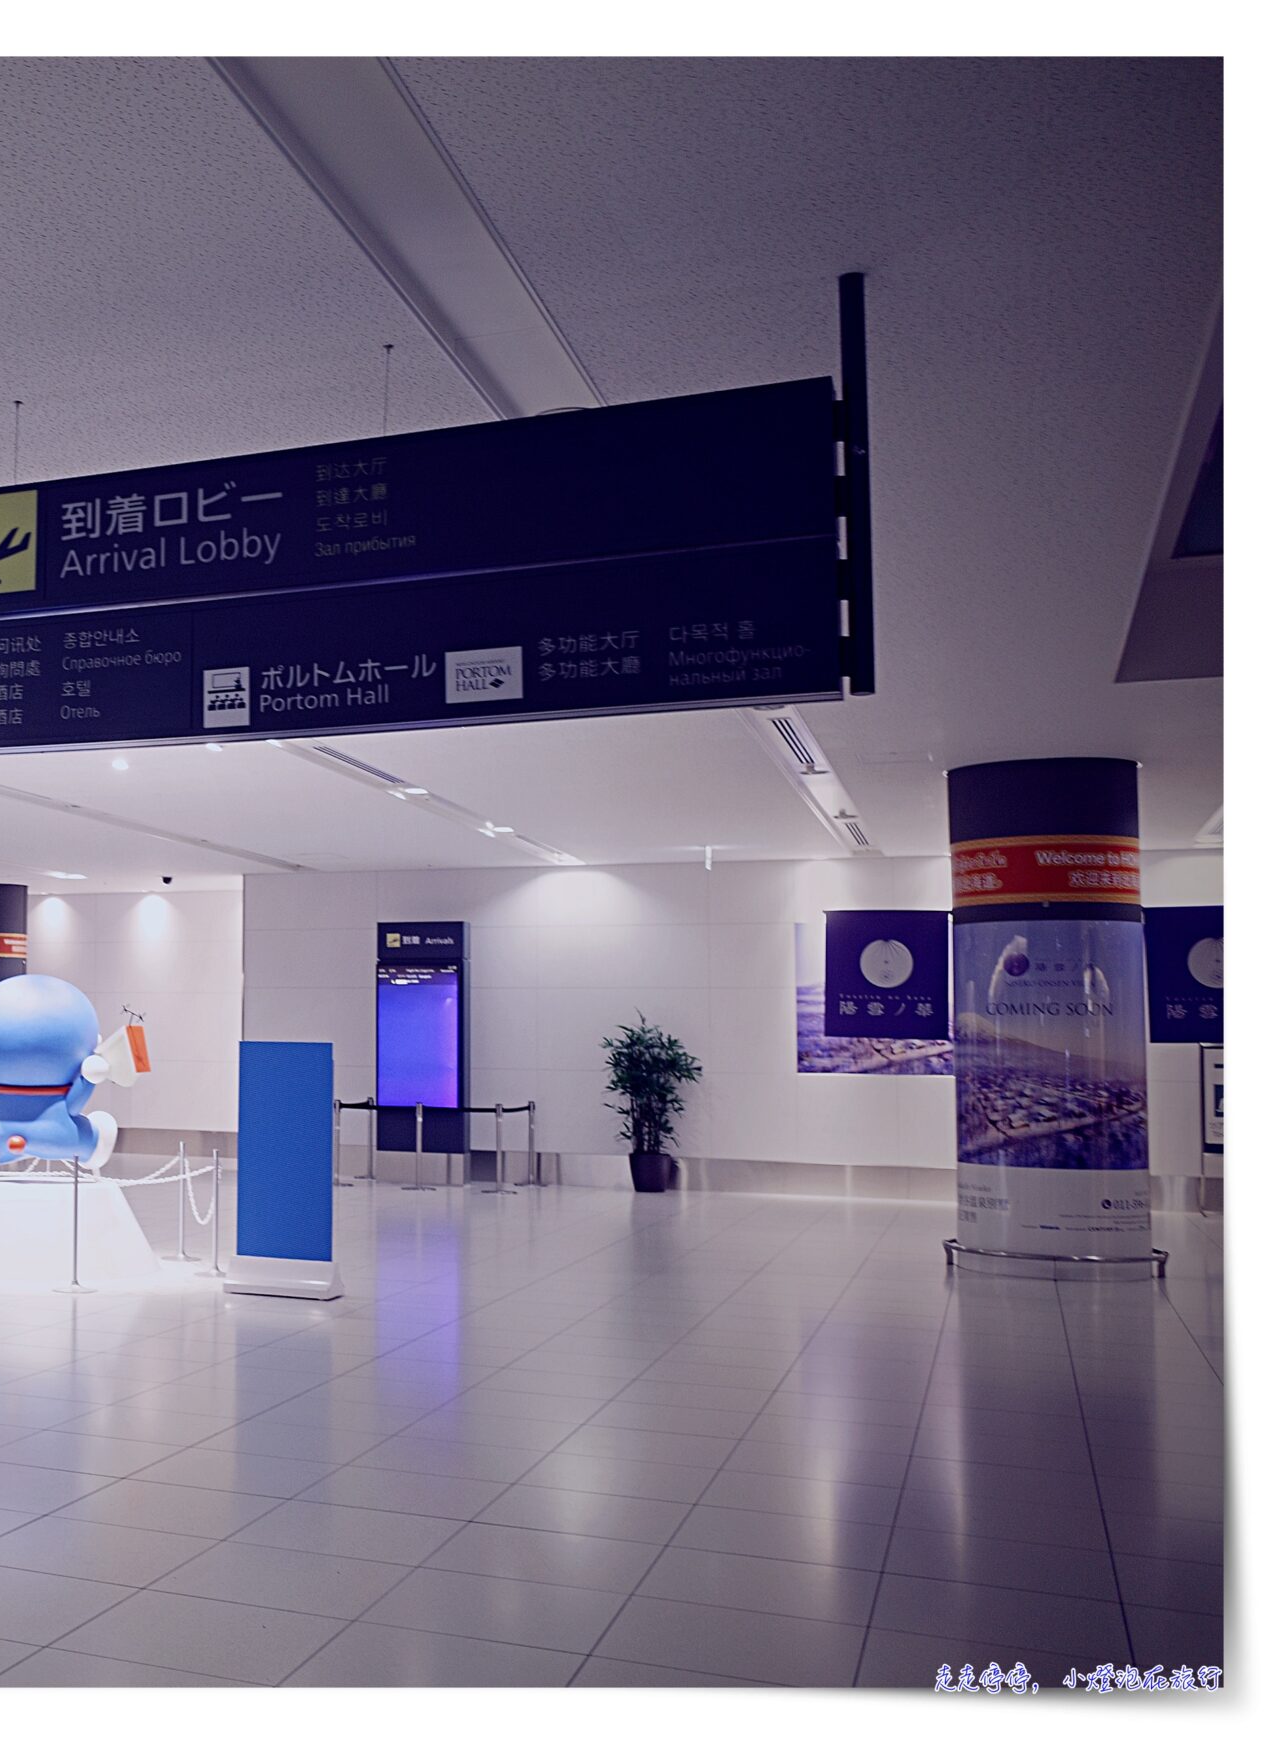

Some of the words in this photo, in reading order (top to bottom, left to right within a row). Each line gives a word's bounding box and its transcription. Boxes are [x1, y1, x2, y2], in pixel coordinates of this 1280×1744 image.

[61, 481, 283, 541] 到着ロビー
[316, 509, 387, 532] 도착로비
[60, 537, 165, 578] Arrival
[180, 527, 281, 565] Lobby
[314, 541, 341, 557] Зал
[345, 535, 416, 556] прибытия
[63, 628, 140, 649] 종합안내소
[670, 622, 729, 643] 다목적
[737, 620, 755, 640] 홀
[538, 630, 640, 656] 多功能大厅
[62, 654, 141, 673] Справочное
[144, 650, 181, 667] бюро
[261, 653, 437, 690] ポルトムホール
[456, 665, 512, 680] PORTOM
[538, 656, 641, 681] 多功能大廳
[456, 679, 489, 692] HALL
[670, 665, 746, 687] нальный
[752, 666, 783, 681] зал
[61, 680, 91, 697] 호텔
[259, 692, 339, 712] Portom
[347, 684, 389, 706] Hall
[60, 705, 100, 720] Отель
[1036, 851, 1104, 865] Welcome
[1108, 852, 1119, 865] to
[985, 1002, 1061, 1017] COMING
[1065, 1002, 1114, 1017] SOON
